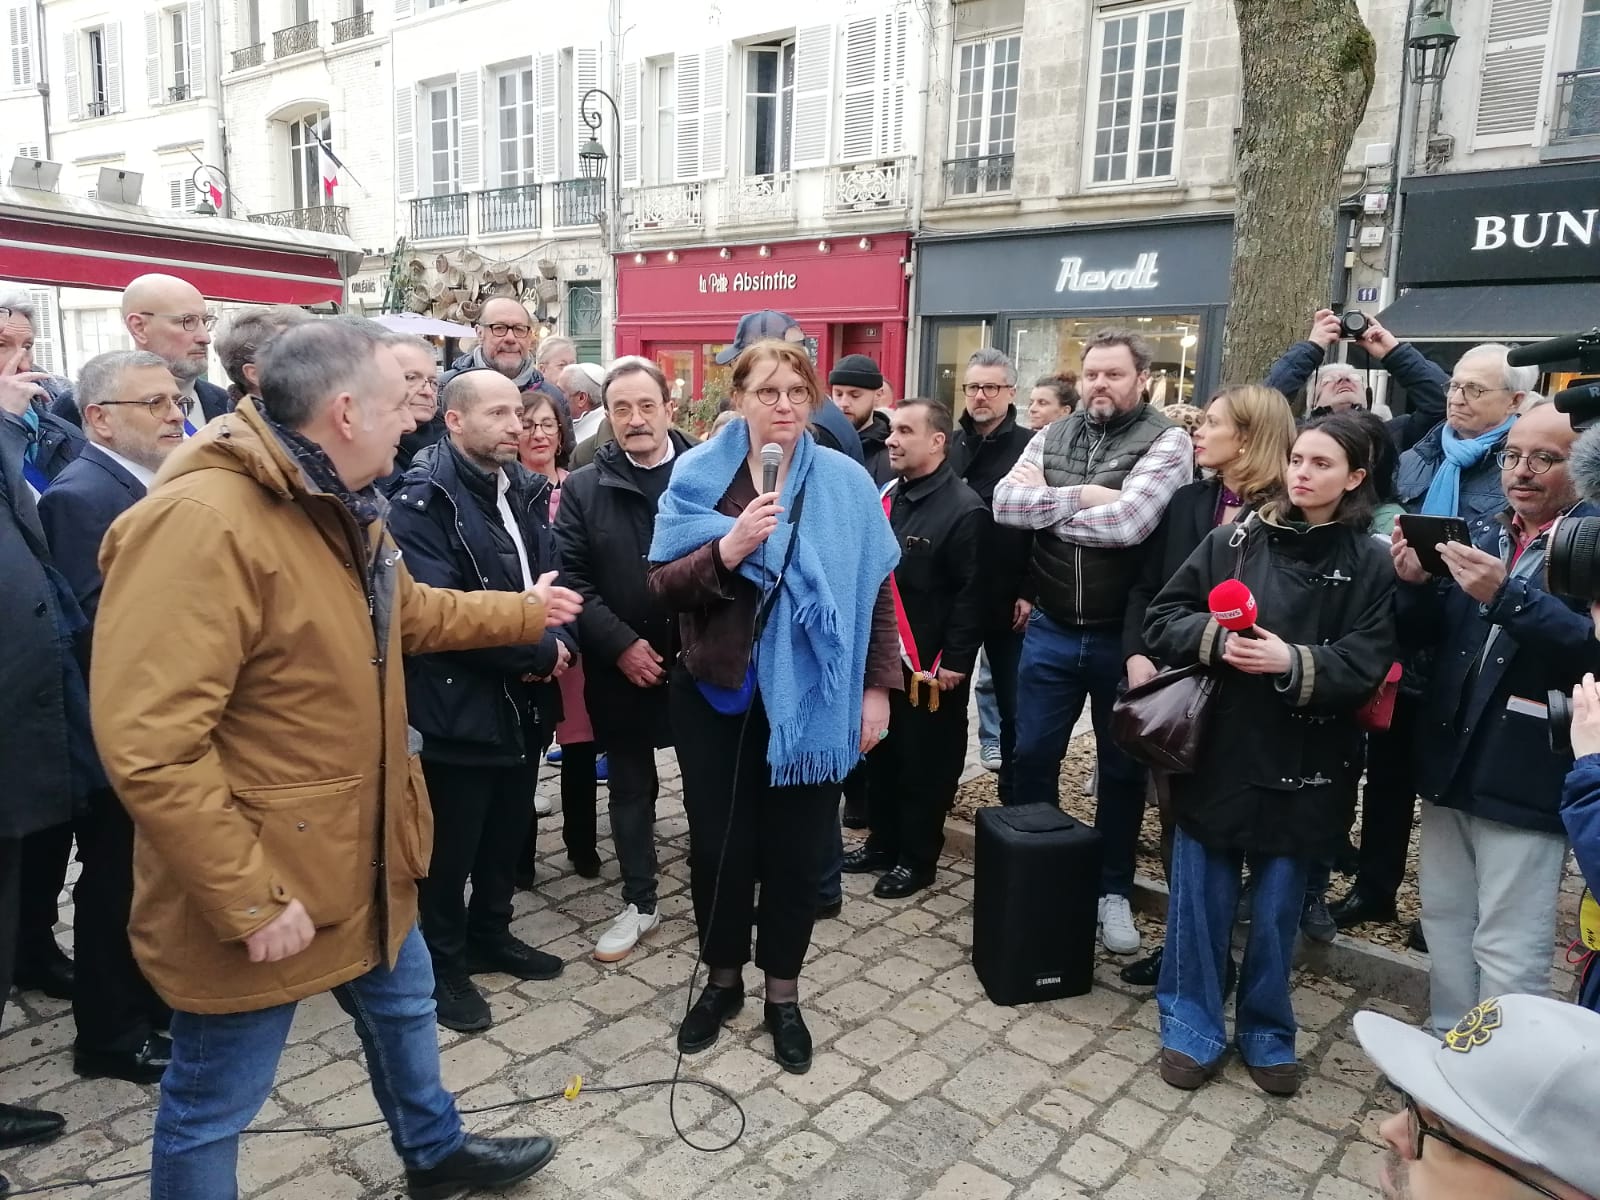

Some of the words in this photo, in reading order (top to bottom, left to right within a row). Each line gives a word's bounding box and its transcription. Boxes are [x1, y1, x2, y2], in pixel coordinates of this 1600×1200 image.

[1471, 209, 1599, 250] BUN
[733, 270, 797, 291] Absinthe
[1055, 252, 1158, 291] Revolt
